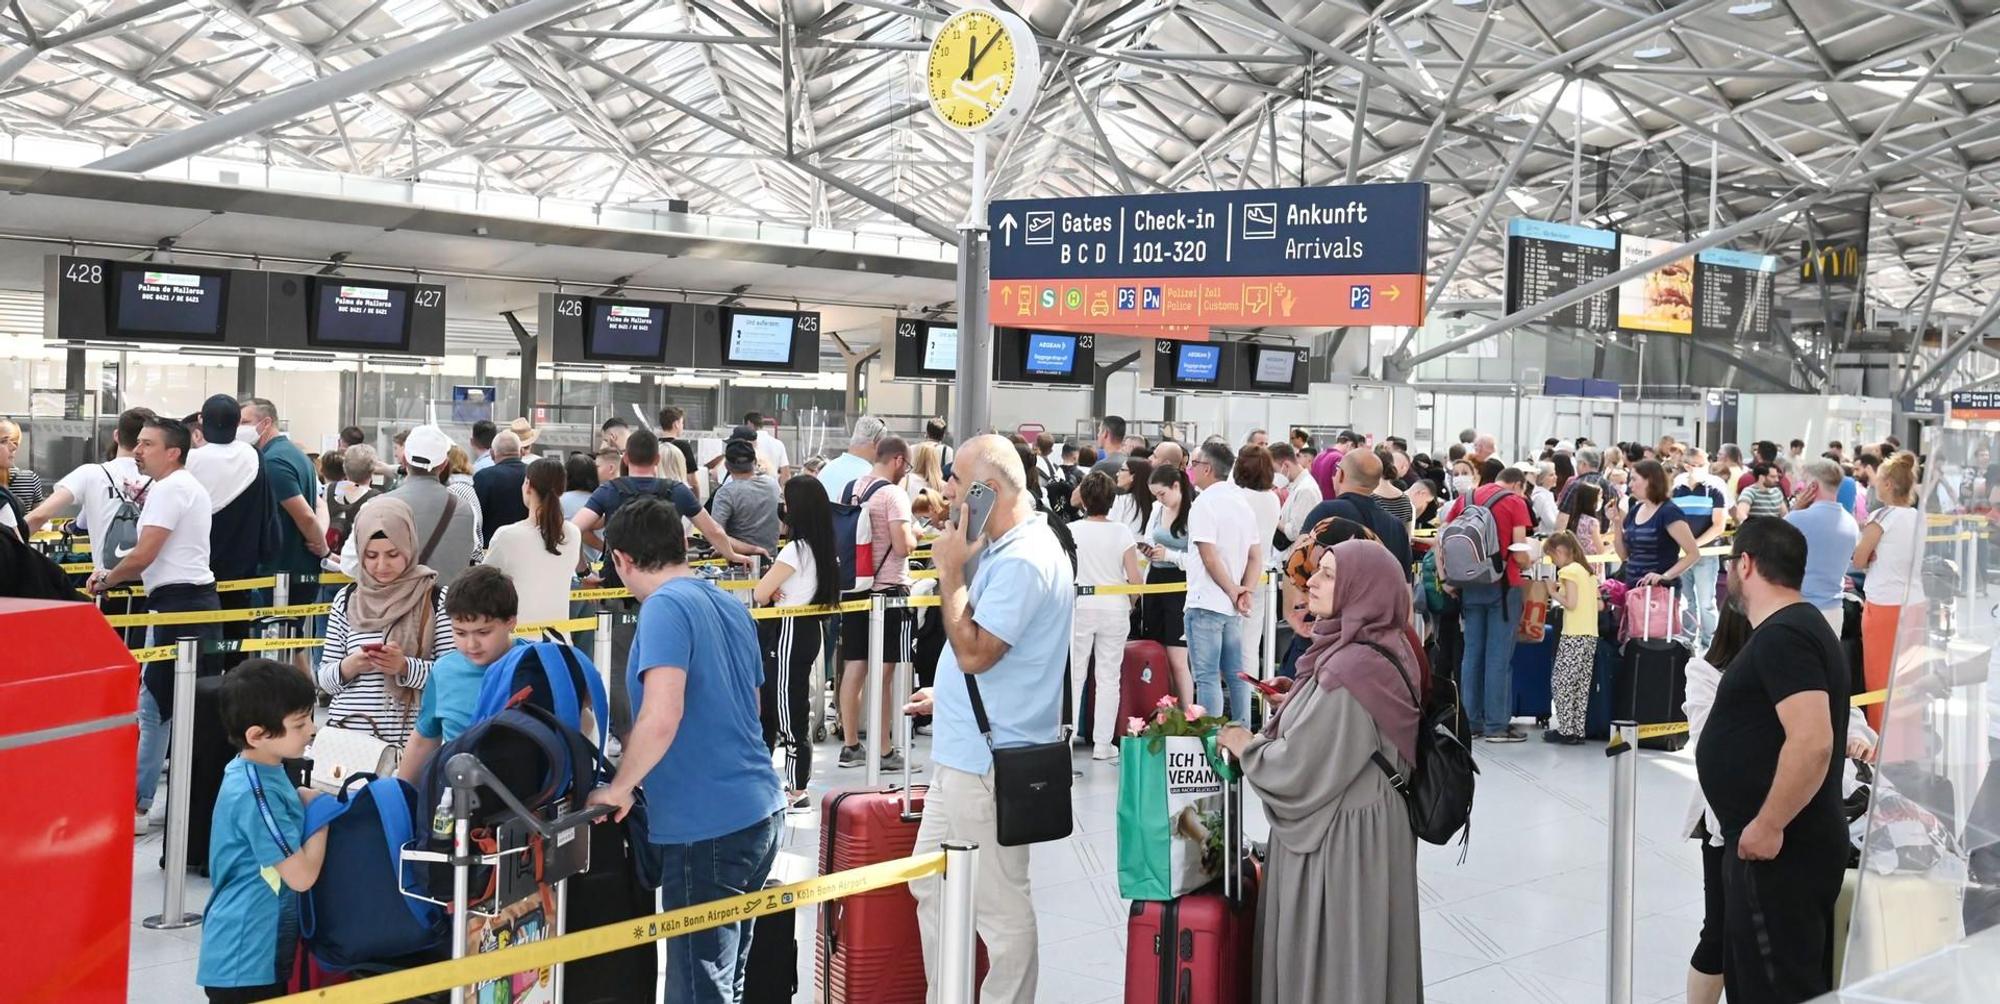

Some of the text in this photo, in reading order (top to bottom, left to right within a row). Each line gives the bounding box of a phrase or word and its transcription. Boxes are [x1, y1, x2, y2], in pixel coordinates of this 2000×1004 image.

[968, 20, 978, 30] 12
[940, 46, 950, 57] 10
[997, 41, 1004, 50] 2
[1002, 61, 1008, 71] 3
[936, 70, 942, 78] 9
[941, 88, 946, 99] 8
[968, 109, 974, 119] 6
[985, 102, 991, 112] 5
[1134, 208, 1214, 231] Check-in
[1287, 202, 1368, 226] Ankunft
[1062, 212, 1112, 232] Gates
[1061, 243, 1106, 264] B C D
[1133, 240, 1206, 263] 101-320
[1286, 236, 1363, 260] Arrivals
[66, 264, 102, 284] 428
[138, 284, 160, 292] Palma
[173, 286, 204, 295] Mallorca
[1168, 288, 1197, 298] Polizei
[1204, 288, 1220, 297] Zoll
[415, 290, 441, 307] 427
[1042, 289, 1054, 308] S
[558, 300, 582, 316] 426
[1168, 302, 1192, 310] Police
[1204, 302, 1239, 310] Customs
[798, 317, 817, 331] 425
[898, 323, 916, 337] 424
[1157, 341, 1171, 354] 422
[1169, 753, 1194, 767] ICH
[797, 877, 867, 899] Köln Bonn Airport
[661, 906, 739, 932] Köln Bonn Airport
